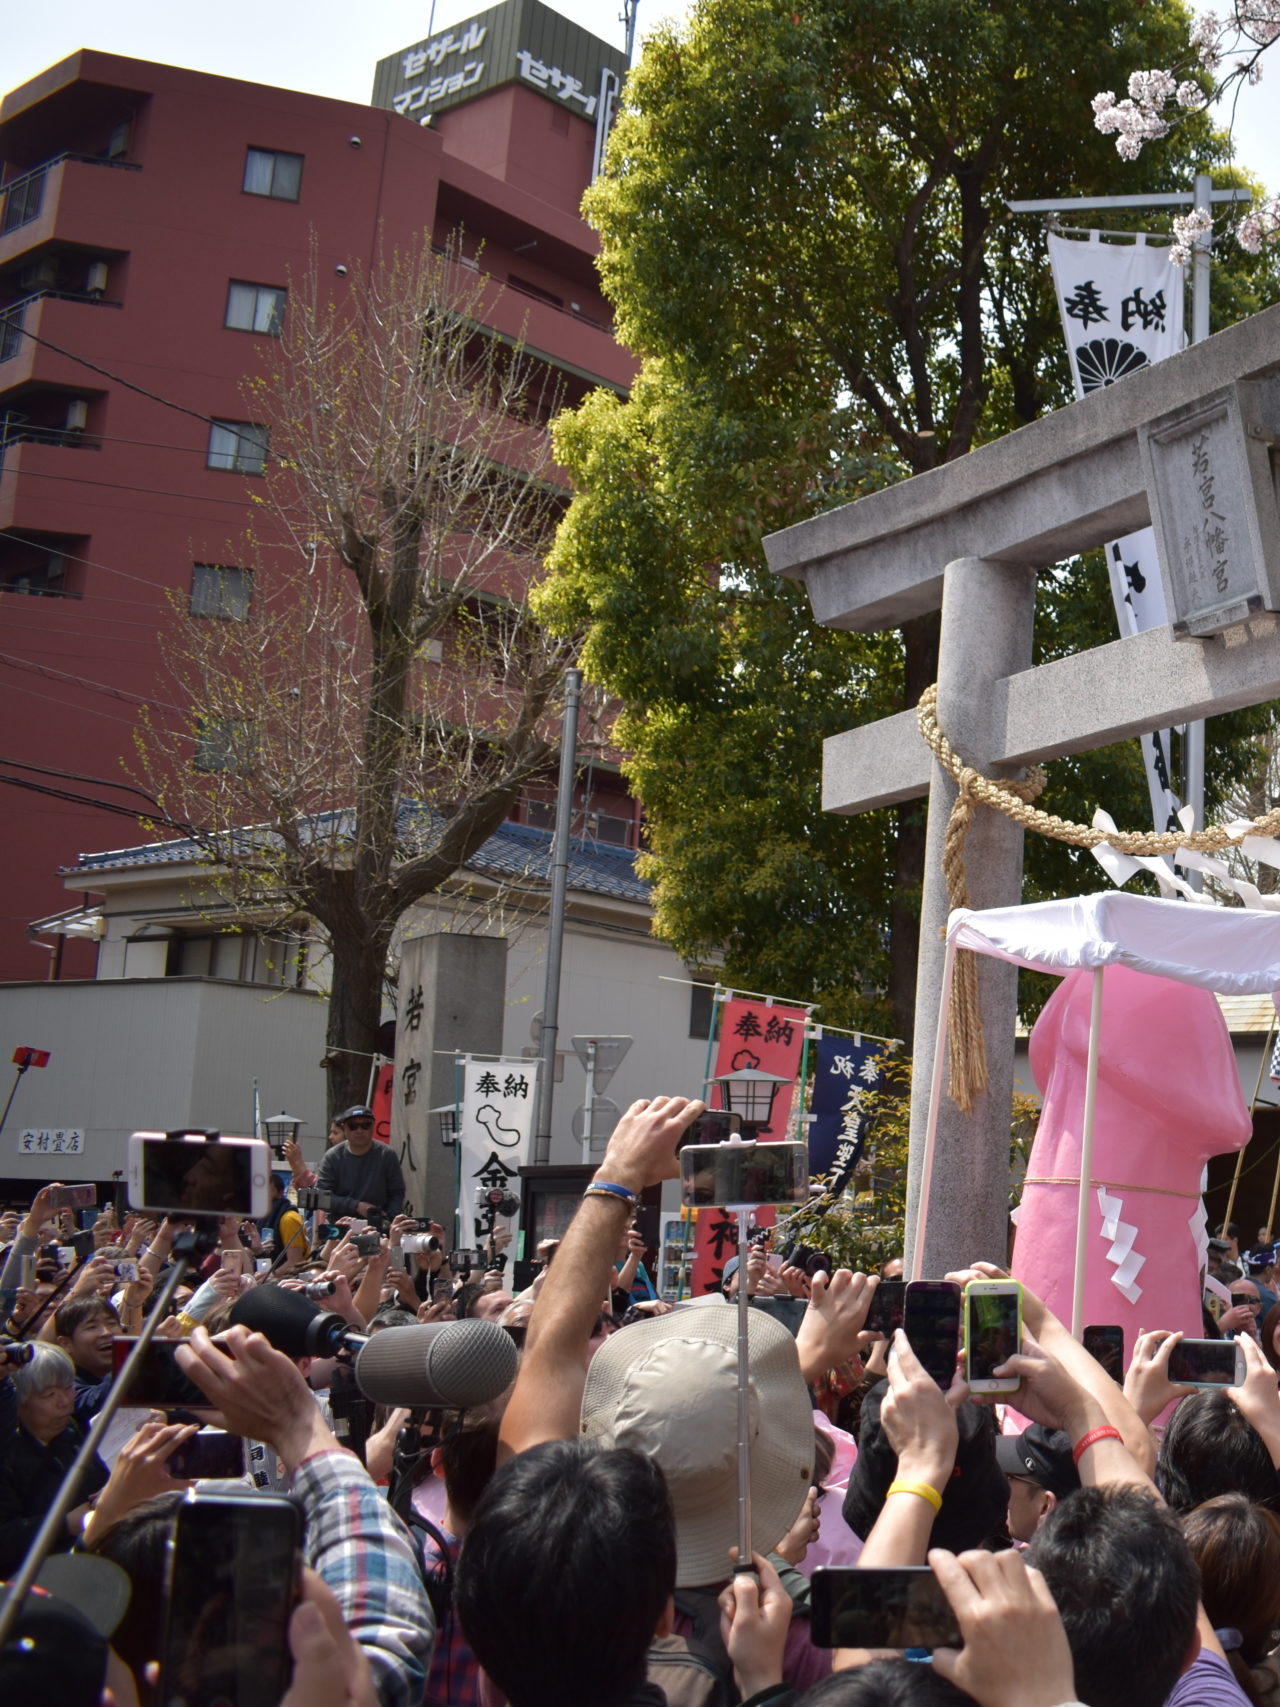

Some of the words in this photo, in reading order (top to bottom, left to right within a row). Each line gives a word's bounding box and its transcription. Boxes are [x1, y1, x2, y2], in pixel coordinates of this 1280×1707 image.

[403, 23, 487, 79] セザール
[393, 61, 486, 114] マンション
[1192, 434, 1229, 593] 若宮八幡宮
[733, 1010, 795, 1047] 奉納
[475, 1071, 529, 1099] 奉納
[23, 1131, 80, 1152] 安村畳店
